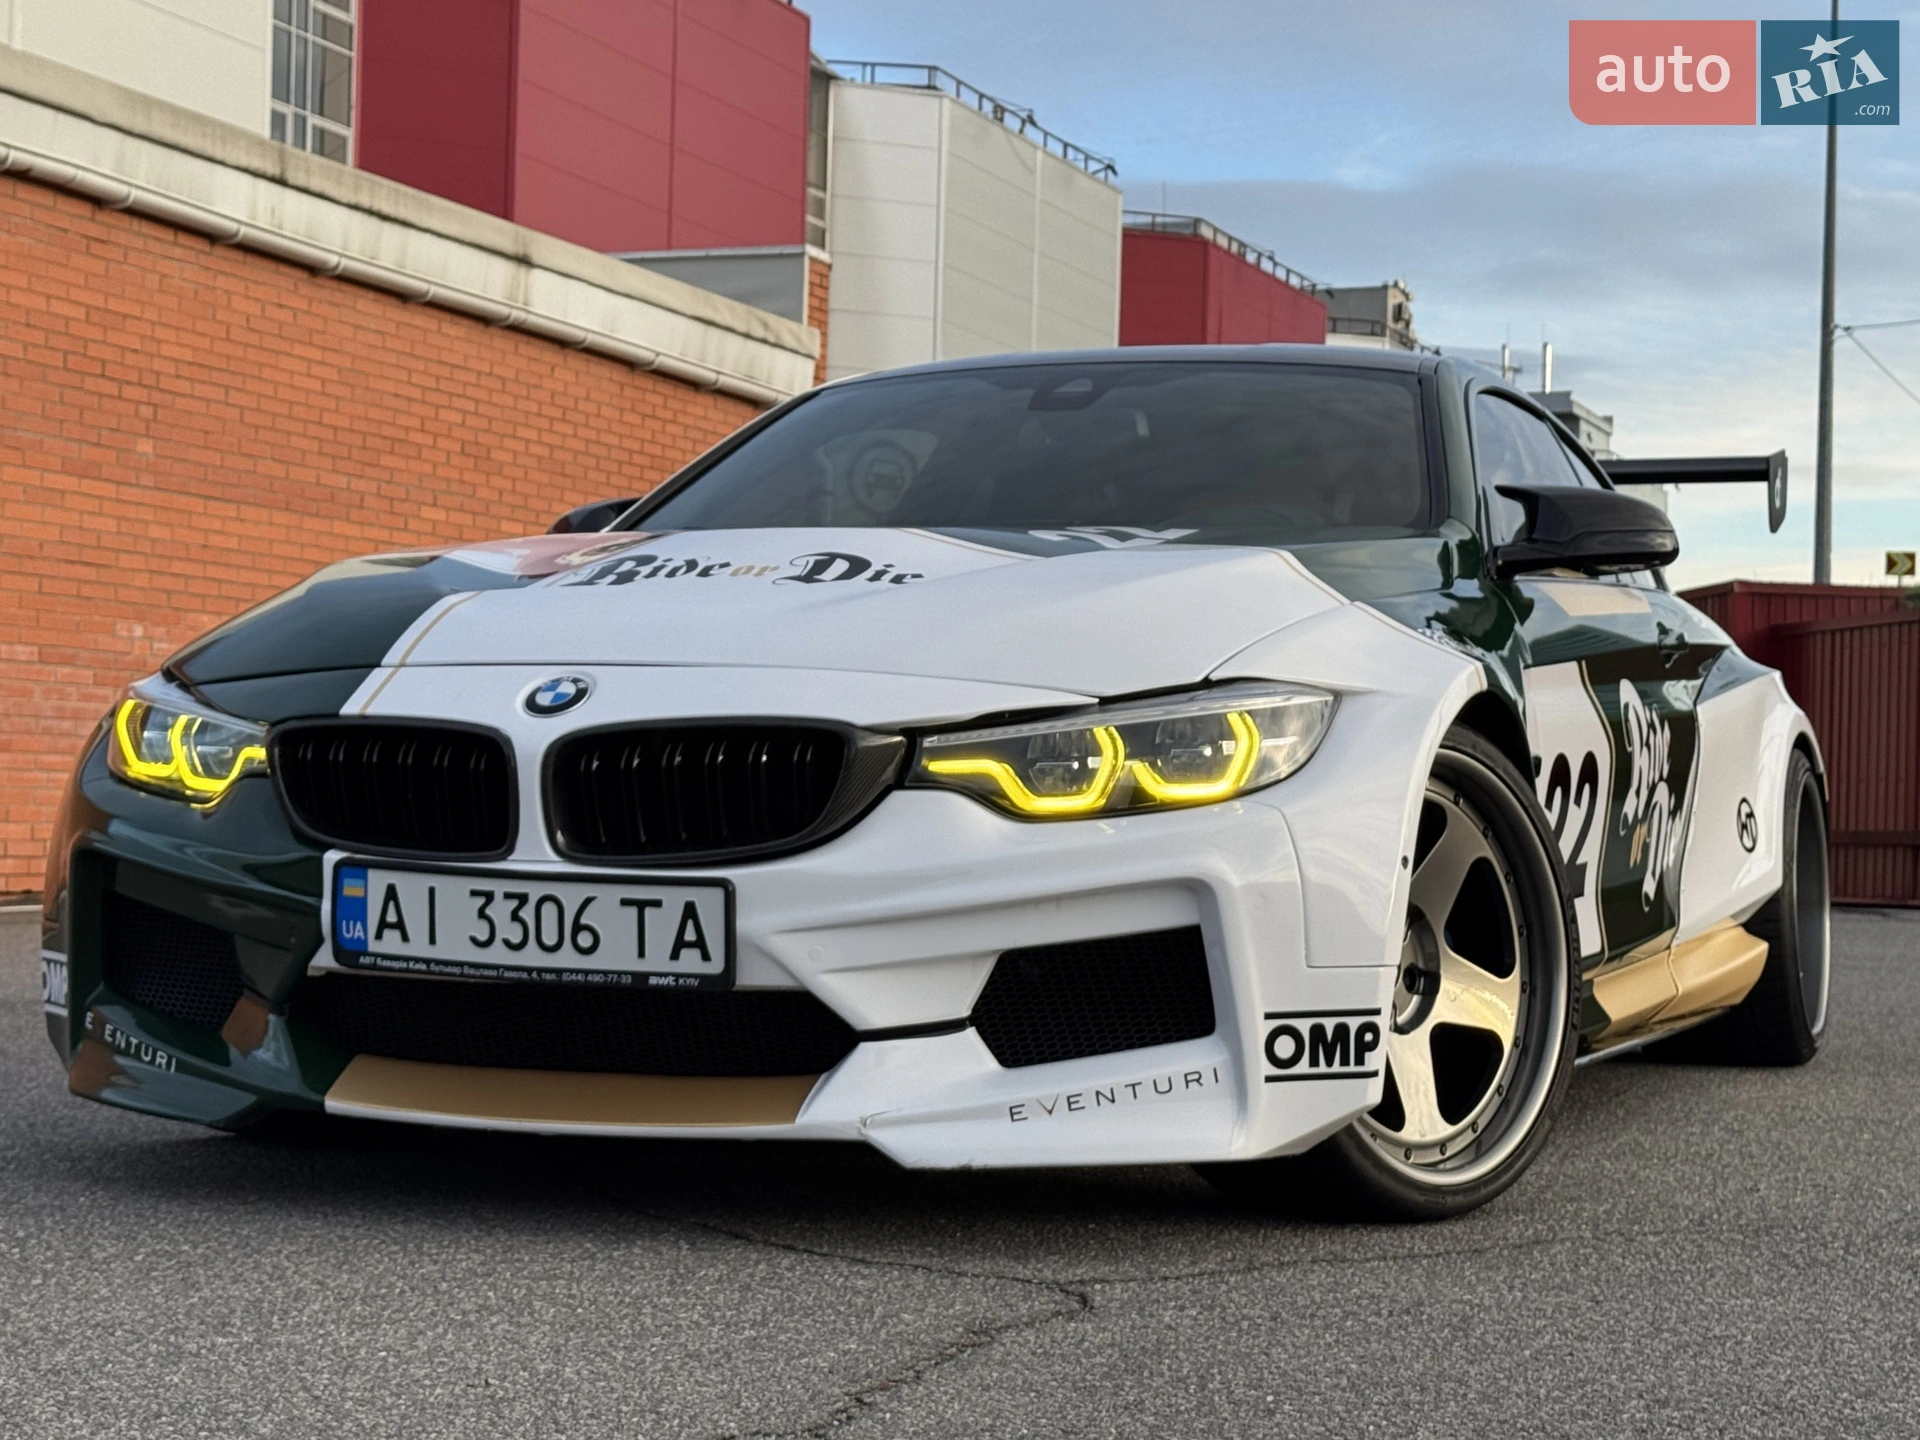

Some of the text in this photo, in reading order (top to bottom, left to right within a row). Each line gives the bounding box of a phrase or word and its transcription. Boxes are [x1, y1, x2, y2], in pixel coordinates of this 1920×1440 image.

[560, 551, 926, 587] Ride or Die
[1533, 750, 1599, 899] 22
[341, 920, 365, 941] UA
[373, 882, 713, 963] AI 3306 TA
[561, 971, 586, 983] (044)
[587, 973, 633, 985] 490-77-33
[84, 1011, 177, 1075] EENTURI
[1264, 1020, 1381, 1070] OMP
[1009, 1066, 1219, 1123] EVENTURI
